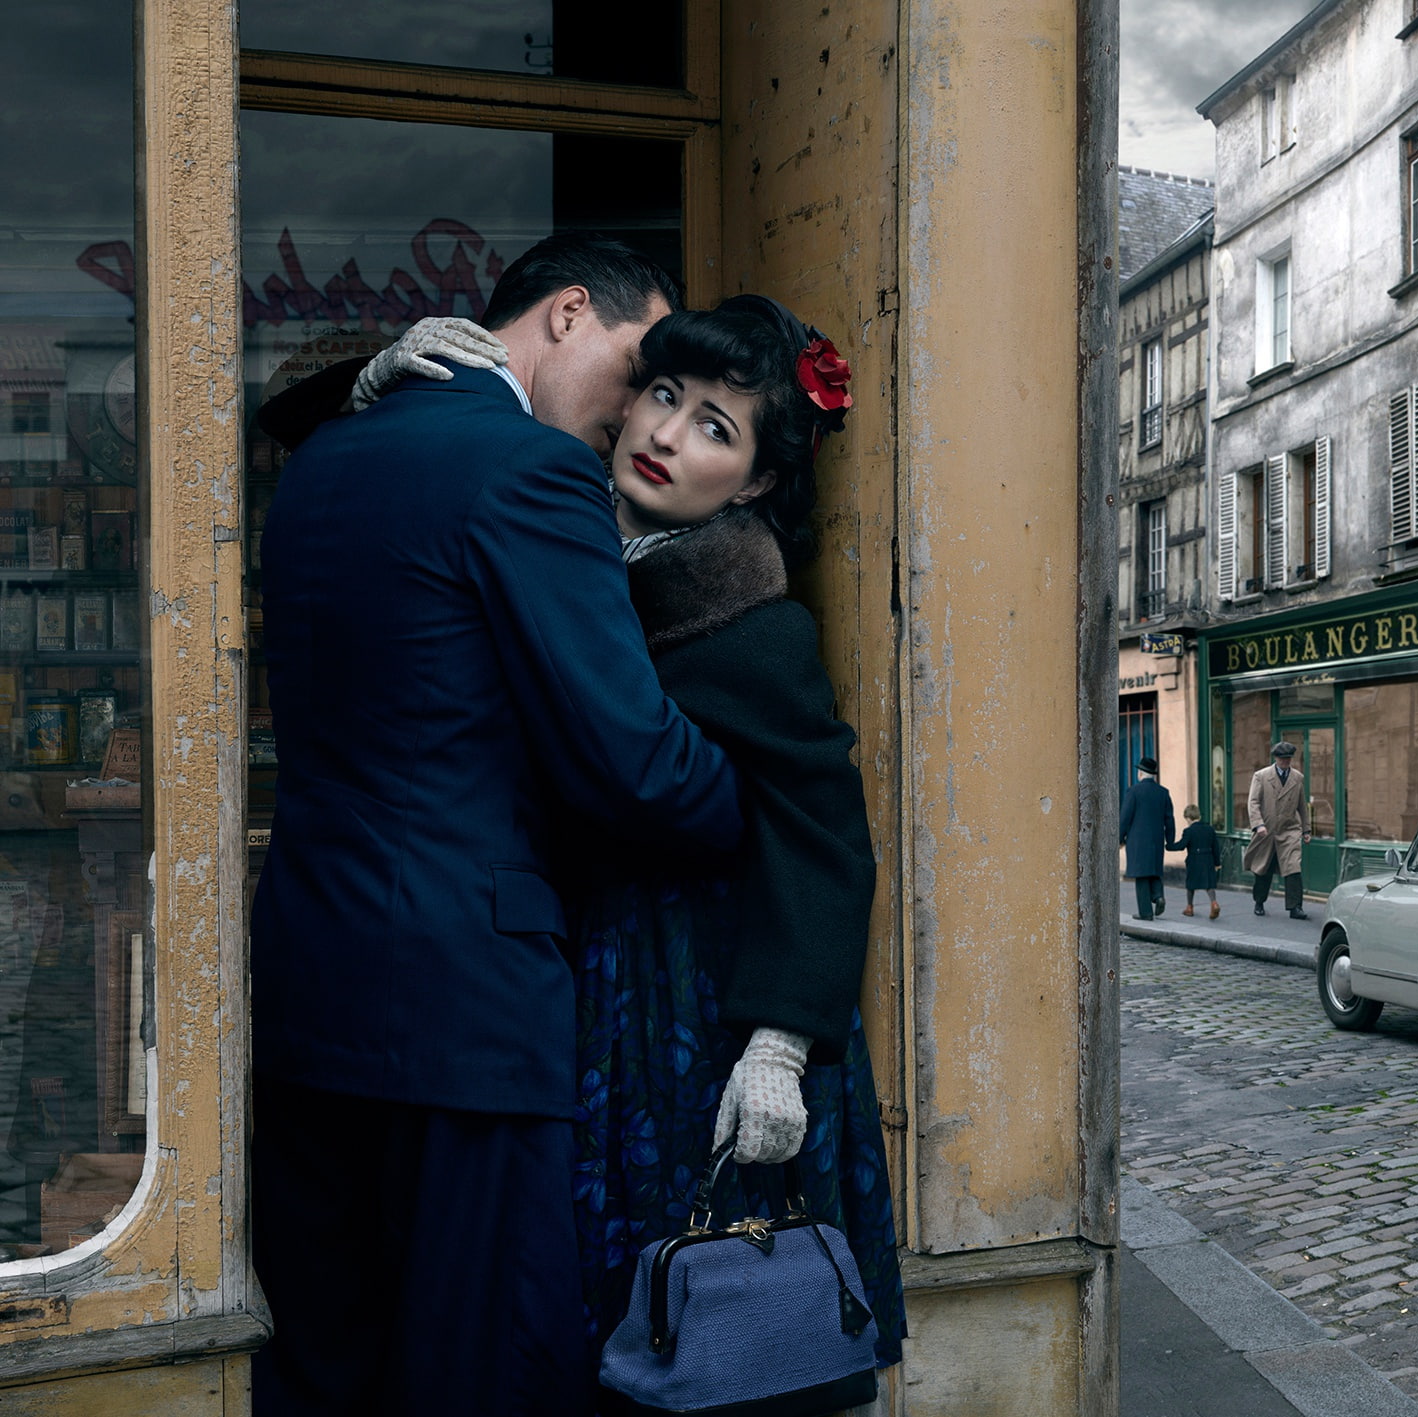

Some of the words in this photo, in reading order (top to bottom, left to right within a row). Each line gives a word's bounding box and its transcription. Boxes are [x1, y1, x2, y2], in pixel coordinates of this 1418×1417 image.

[316, 339, 382, 354] CAFÉS
[1151, 635, 1181, 653] ASTRA
[1119, 671, 1158, 690] venir
